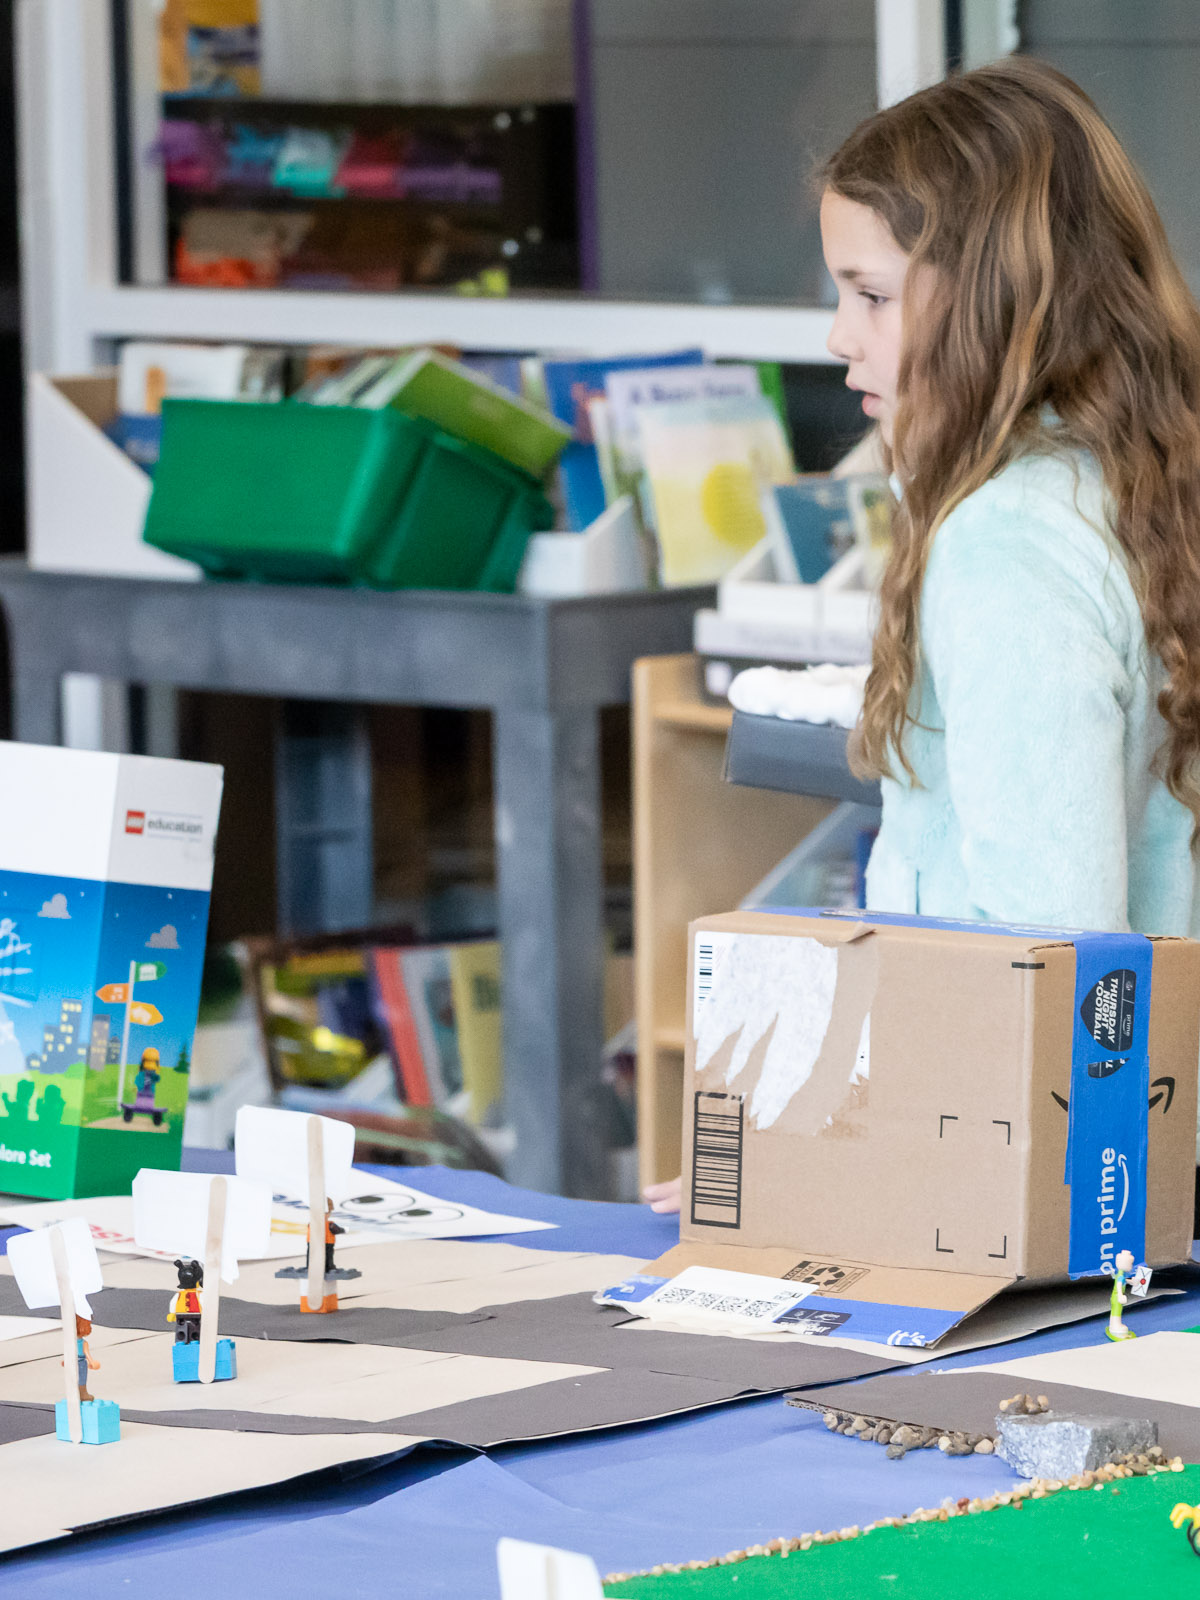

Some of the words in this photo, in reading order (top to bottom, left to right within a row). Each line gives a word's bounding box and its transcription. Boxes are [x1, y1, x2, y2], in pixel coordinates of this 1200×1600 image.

[148, 818, 203, 834] education
[1093, 980, 1105, 1041] FOOTBALL
[1101, 990, 1111, 1030] NIGHT
[1107, 978, 1119, 1044] THURSDAY
[0, 1144, 27, 1165] lore
[28, 1149, 52, 1168] Set
[1097, 1147, 1118, 1235] prime
